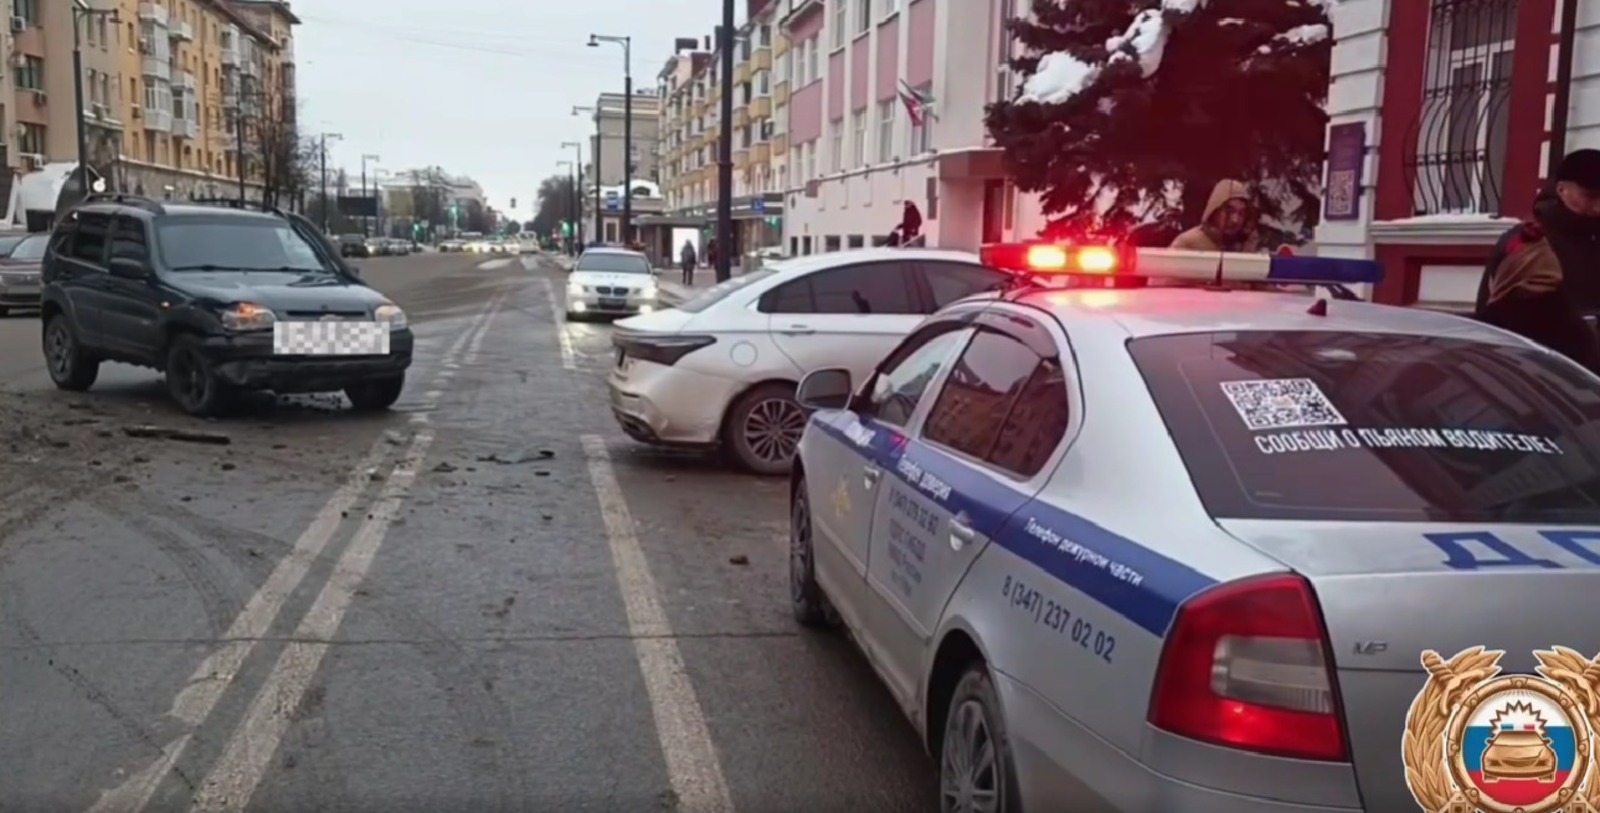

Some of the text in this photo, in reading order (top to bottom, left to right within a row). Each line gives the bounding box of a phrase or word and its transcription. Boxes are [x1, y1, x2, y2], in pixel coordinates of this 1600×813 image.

[1254, 428, 1345, 455] СООБЩИ
[1346, 428, 1359, 448] О
[1360, 427, 1447, 449] ПЬЯНОМ
[1024, 516, 1060, 546] Телефон
[1109, 561, 1144, 587] части
[1002, 575, 1116, 664] 8 (347) 237 02 02
